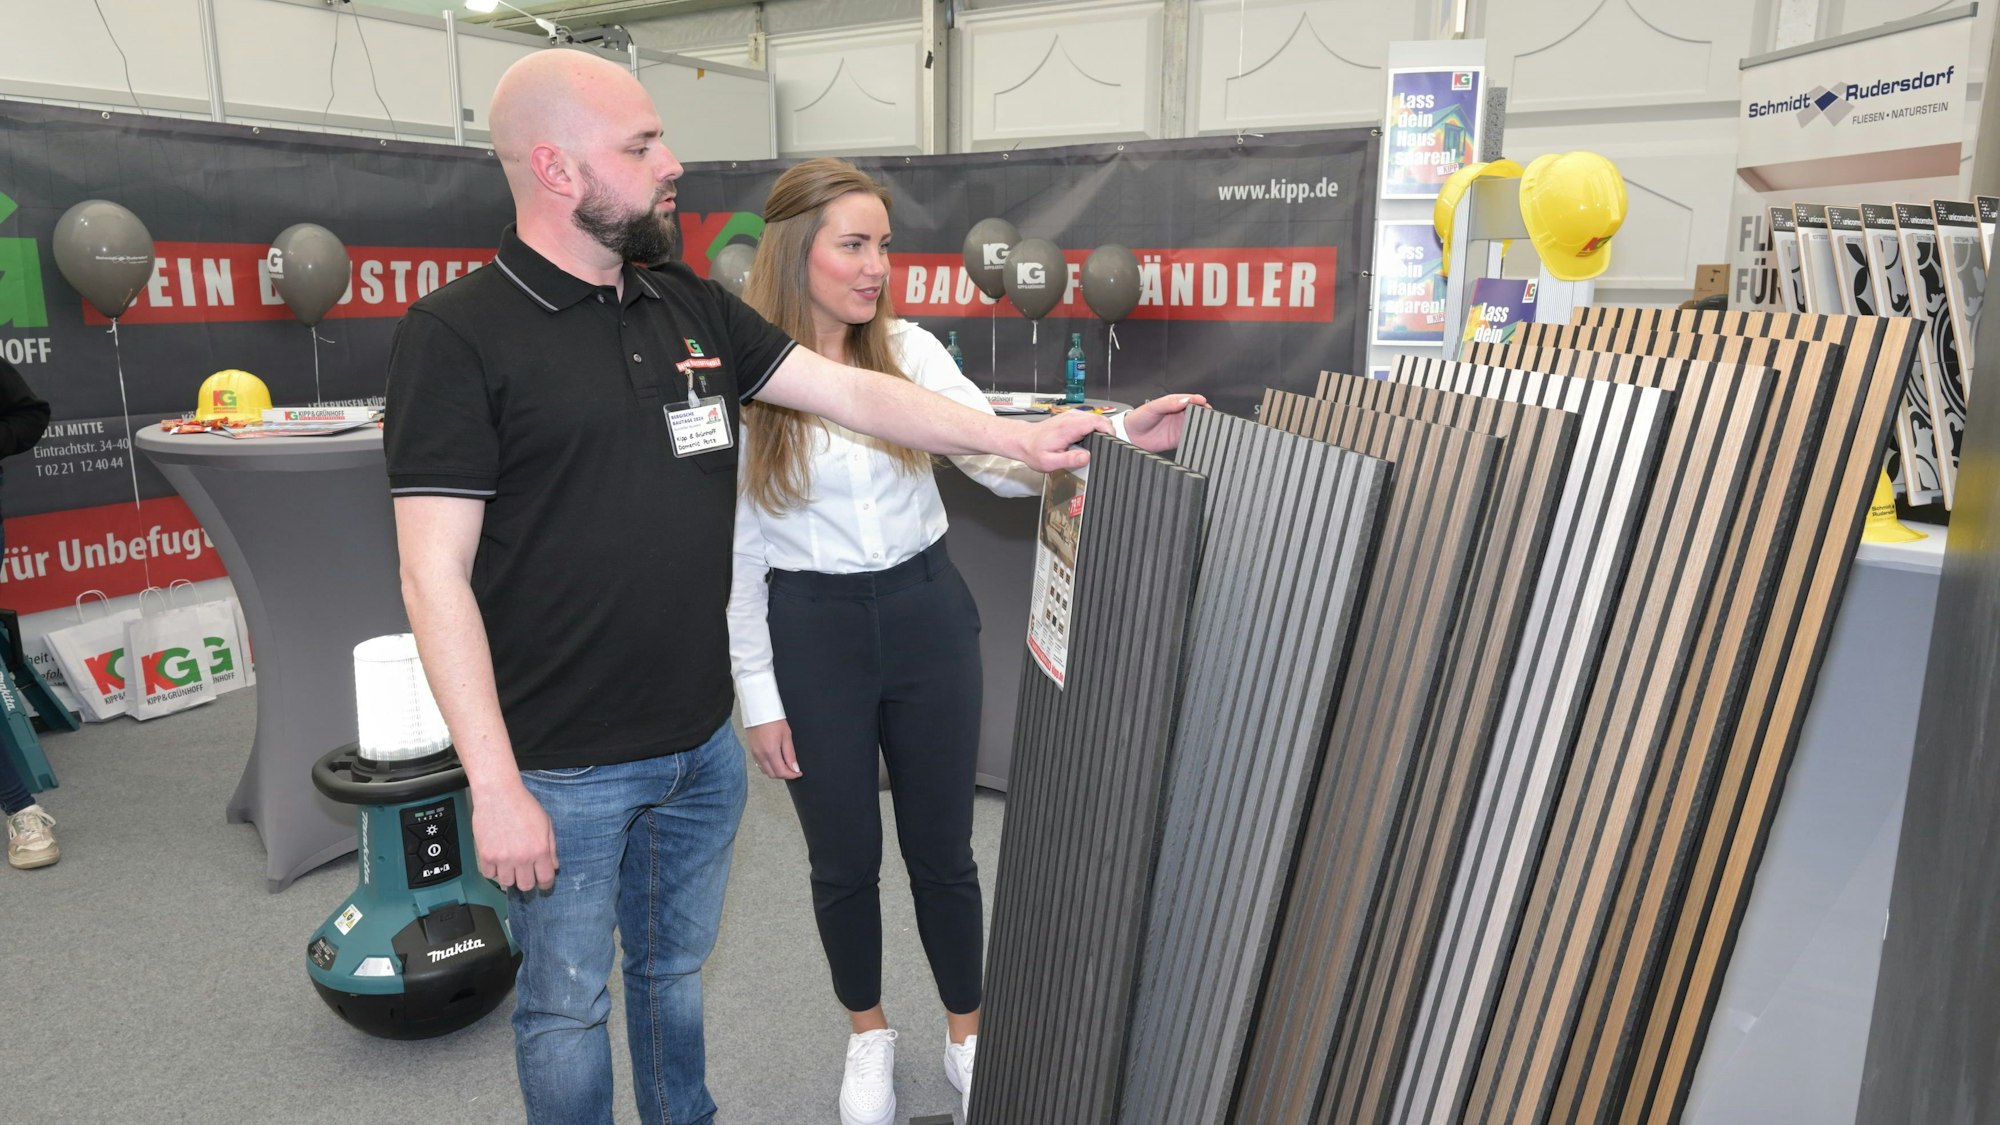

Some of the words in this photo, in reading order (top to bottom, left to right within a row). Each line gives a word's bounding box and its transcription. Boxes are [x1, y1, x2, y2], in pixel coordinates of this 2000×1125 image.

[1399, 92, 1435, 109] Lass
[1749, 94, 1811, 119] Schmidt
[1845, 66, 1955, 101] Rudersdorf
[1397, 111, 1433, 128] dein
[1852, 112, 1885, 125] FLIESEN
[1891, 102, 1949, 119] NATURSTEIN
[1396, 130, 1436, 147] Haus
[1218, 177, 1339, 204] www.kipp.de
[126, 256, 236, 308] EIN
[1480, 303, 1510, 323] Lass
[1474, 325, 1504, 343] dein
[213, 390, 237, 406] KG
[41, 424, 65, 439] LN
[66, 421, 105, 437] MITTE
[33, 442, 98, 460] Eintrachtstr.
[100, 438, 129, 453] 34-40
[36, 464, 43, 477] T
[45, 464, 60, 477] 02
[61, 461, 75, 475] 21
[81, 460, 94, 472] 12
[95, 458, 109, 471] 40
[110, 456, 124, 469] 44
[141, 647, 203, 696] KG
[212, 671, 236, 685] NHOFF
[426, 938, 486, 963] makita
